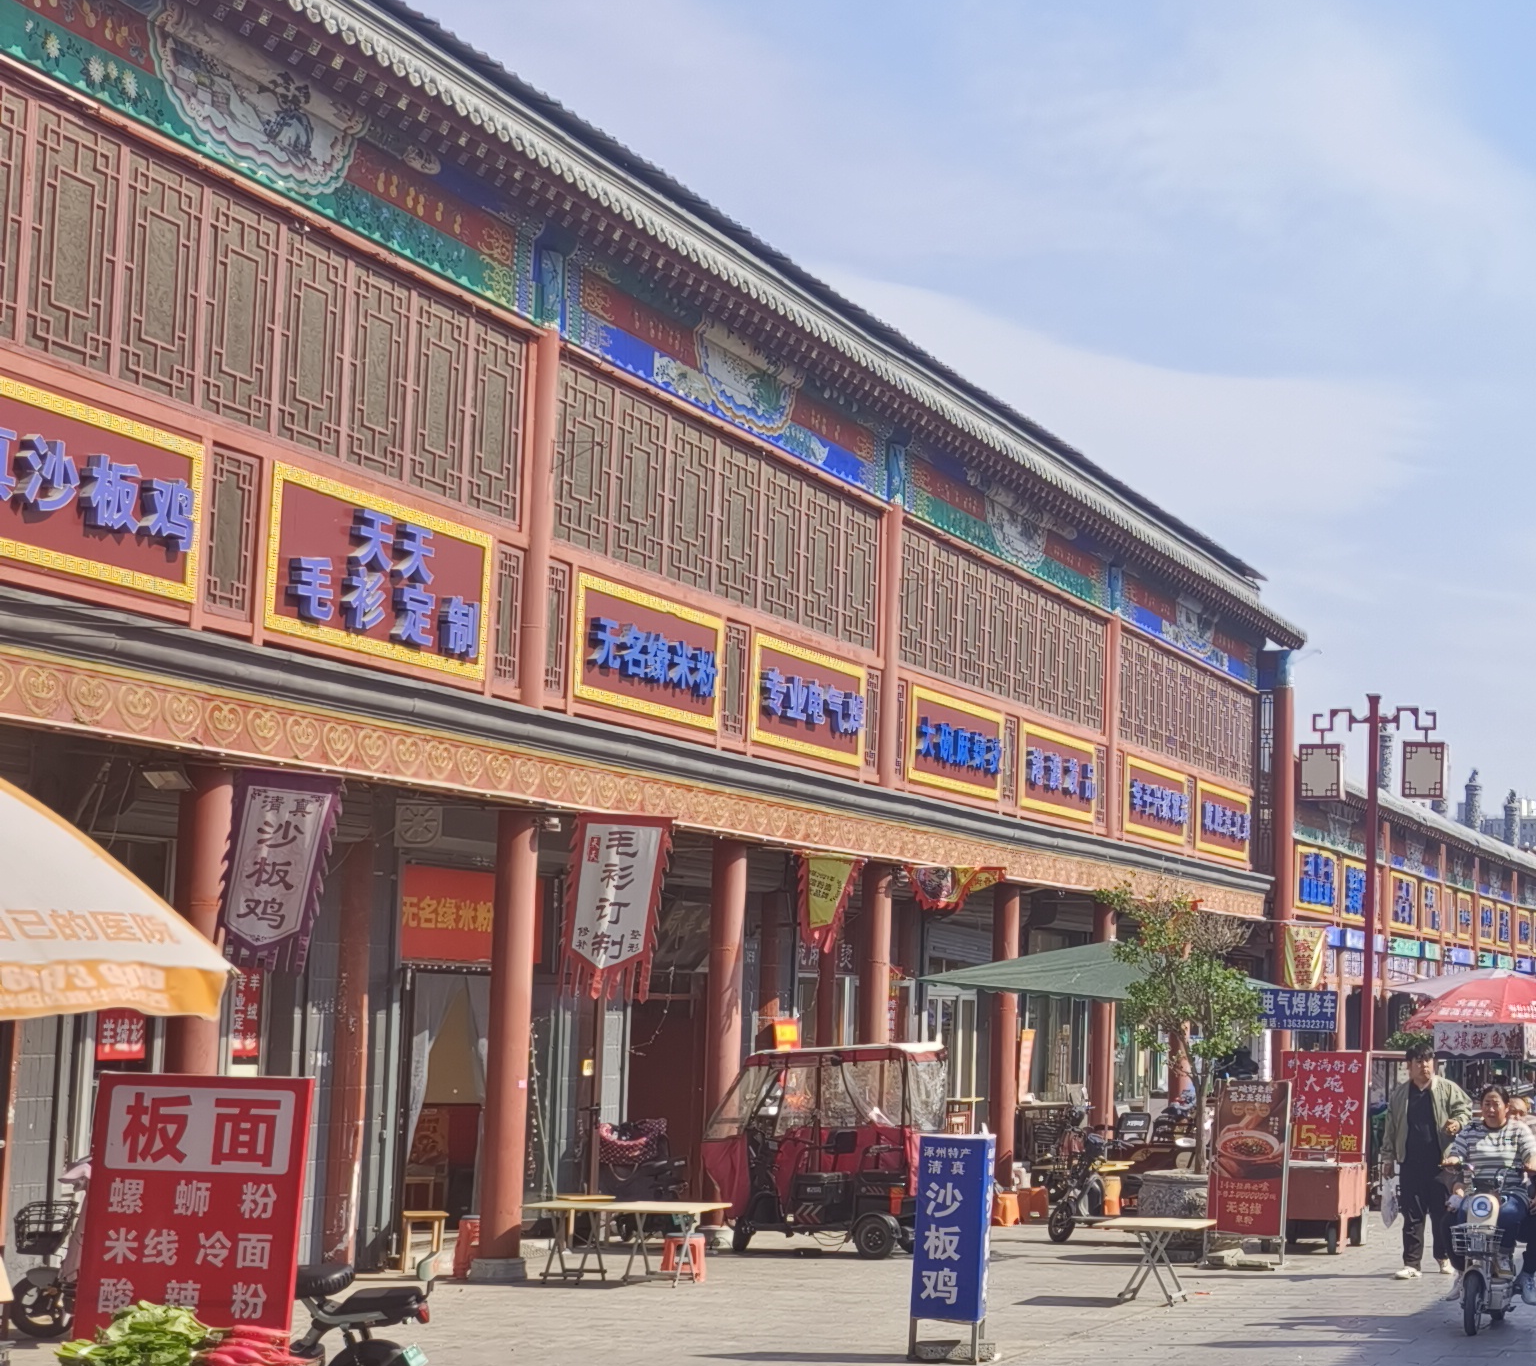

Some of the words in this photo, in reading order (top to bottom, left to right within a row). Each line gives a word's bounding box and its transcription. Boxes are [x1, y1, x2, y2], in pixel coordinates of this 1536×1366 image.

[350, 508, 435, 584] 天天
[288, 556, 480, 658] 毛衫定制
[587, 617, 718, 698] 无名缘米粉
[761, 667, 865, 734] 专业电气焊
[261, 795, 313, 818] 清真
[237, 820, 305, 930] 沙板鸡
[591, 830, 639, 960] 毛衫订制
[402, 895, 494, 932] 无名缘米粉
[1261, 990, 1336, 1017] 电气焊修车
[1304, 1074, 1345, 1093] 大碗
[122, 1091, 283, 1168] 板面
[923, 1146, 972, 1159] 涿州特产
[927, 1159, 966, 1176] 清真
[108, 1177, 278, 1219] 螺蛳粉
[103, 1227, 179, 1267] 米线
[195, 1230, 273, 1270] 冷面
[920, 1181, 964, 1306] 沙板鸡
[97, 1277, 267, 1320] 酸辣粉
